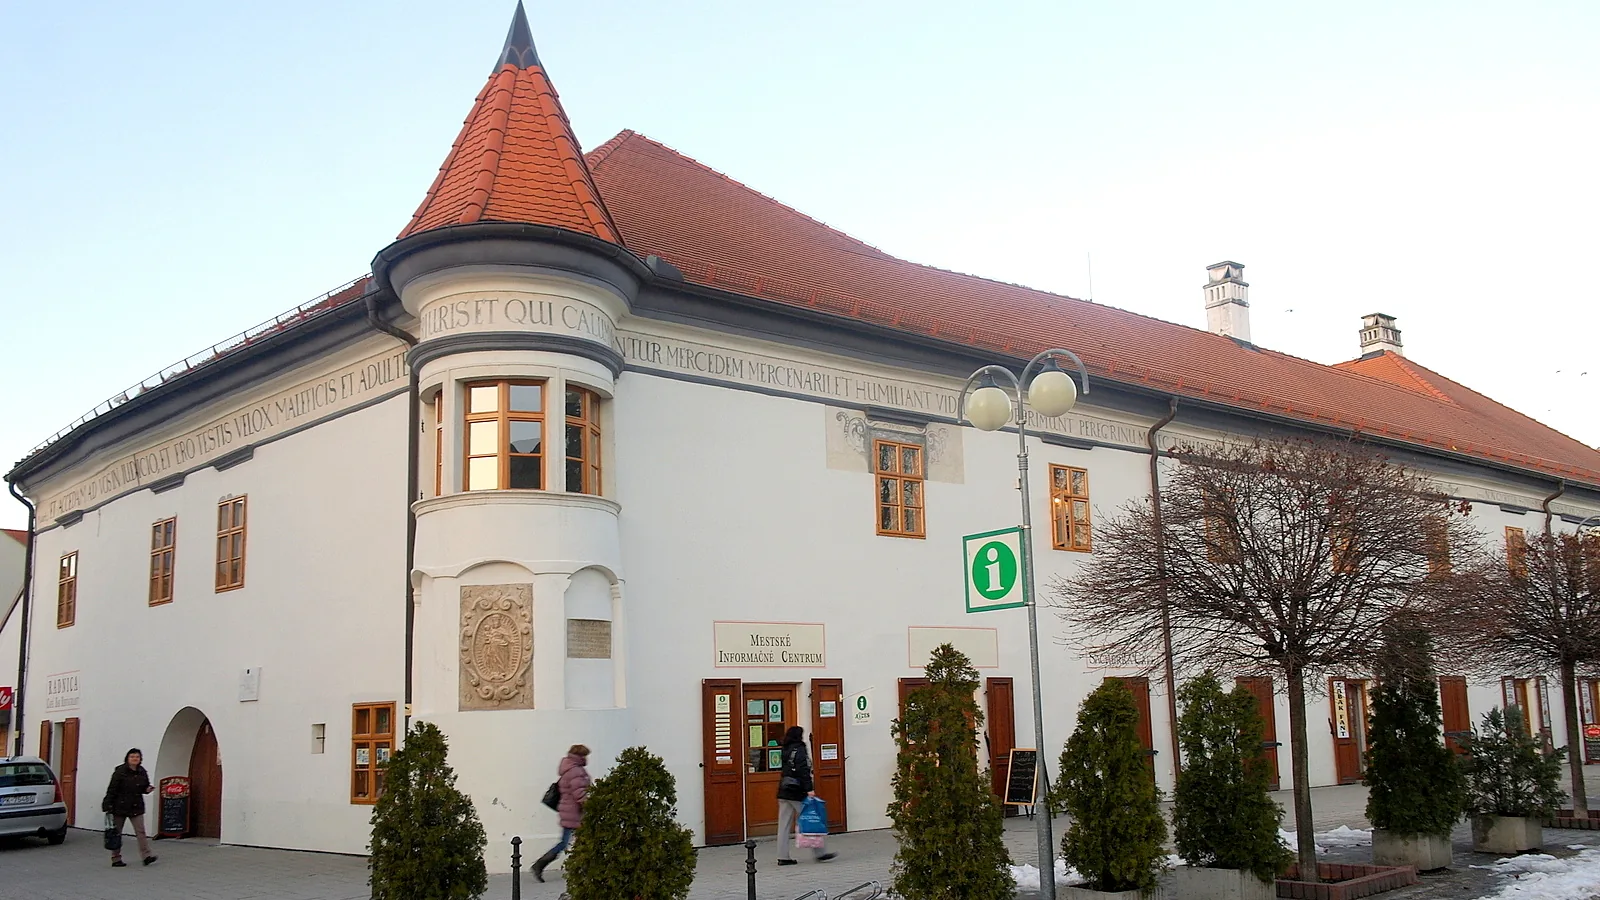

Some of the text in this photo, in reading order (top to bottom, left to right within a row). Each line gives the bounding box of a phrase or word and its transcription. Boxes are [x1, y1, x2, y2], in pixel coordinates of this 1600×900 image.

[474, 299, 499, 325] ET
[504, 299, 553, 326] QUI
[666, 345, 745, 379] MERCEDEM
[835, 376, 852, 397] ET
[855, 380, 931, 410] HUMILIANT
[1079, 419, 1147, 446] PEREGRINUM
[160, 446, 172, 471] ET
[174, 437, 196, 466] ERO
[196, 422, 233, 456] TESTIS
[234, 403, 275, 440] VELOX
[341, 371, 355, 400] ET
[750, 633, 792, 647] MESTSKÉ
[719, 650, 823, 663] INFORMAČNÉ CENTRUM
[48, 676, 79, 695] RADNICA
